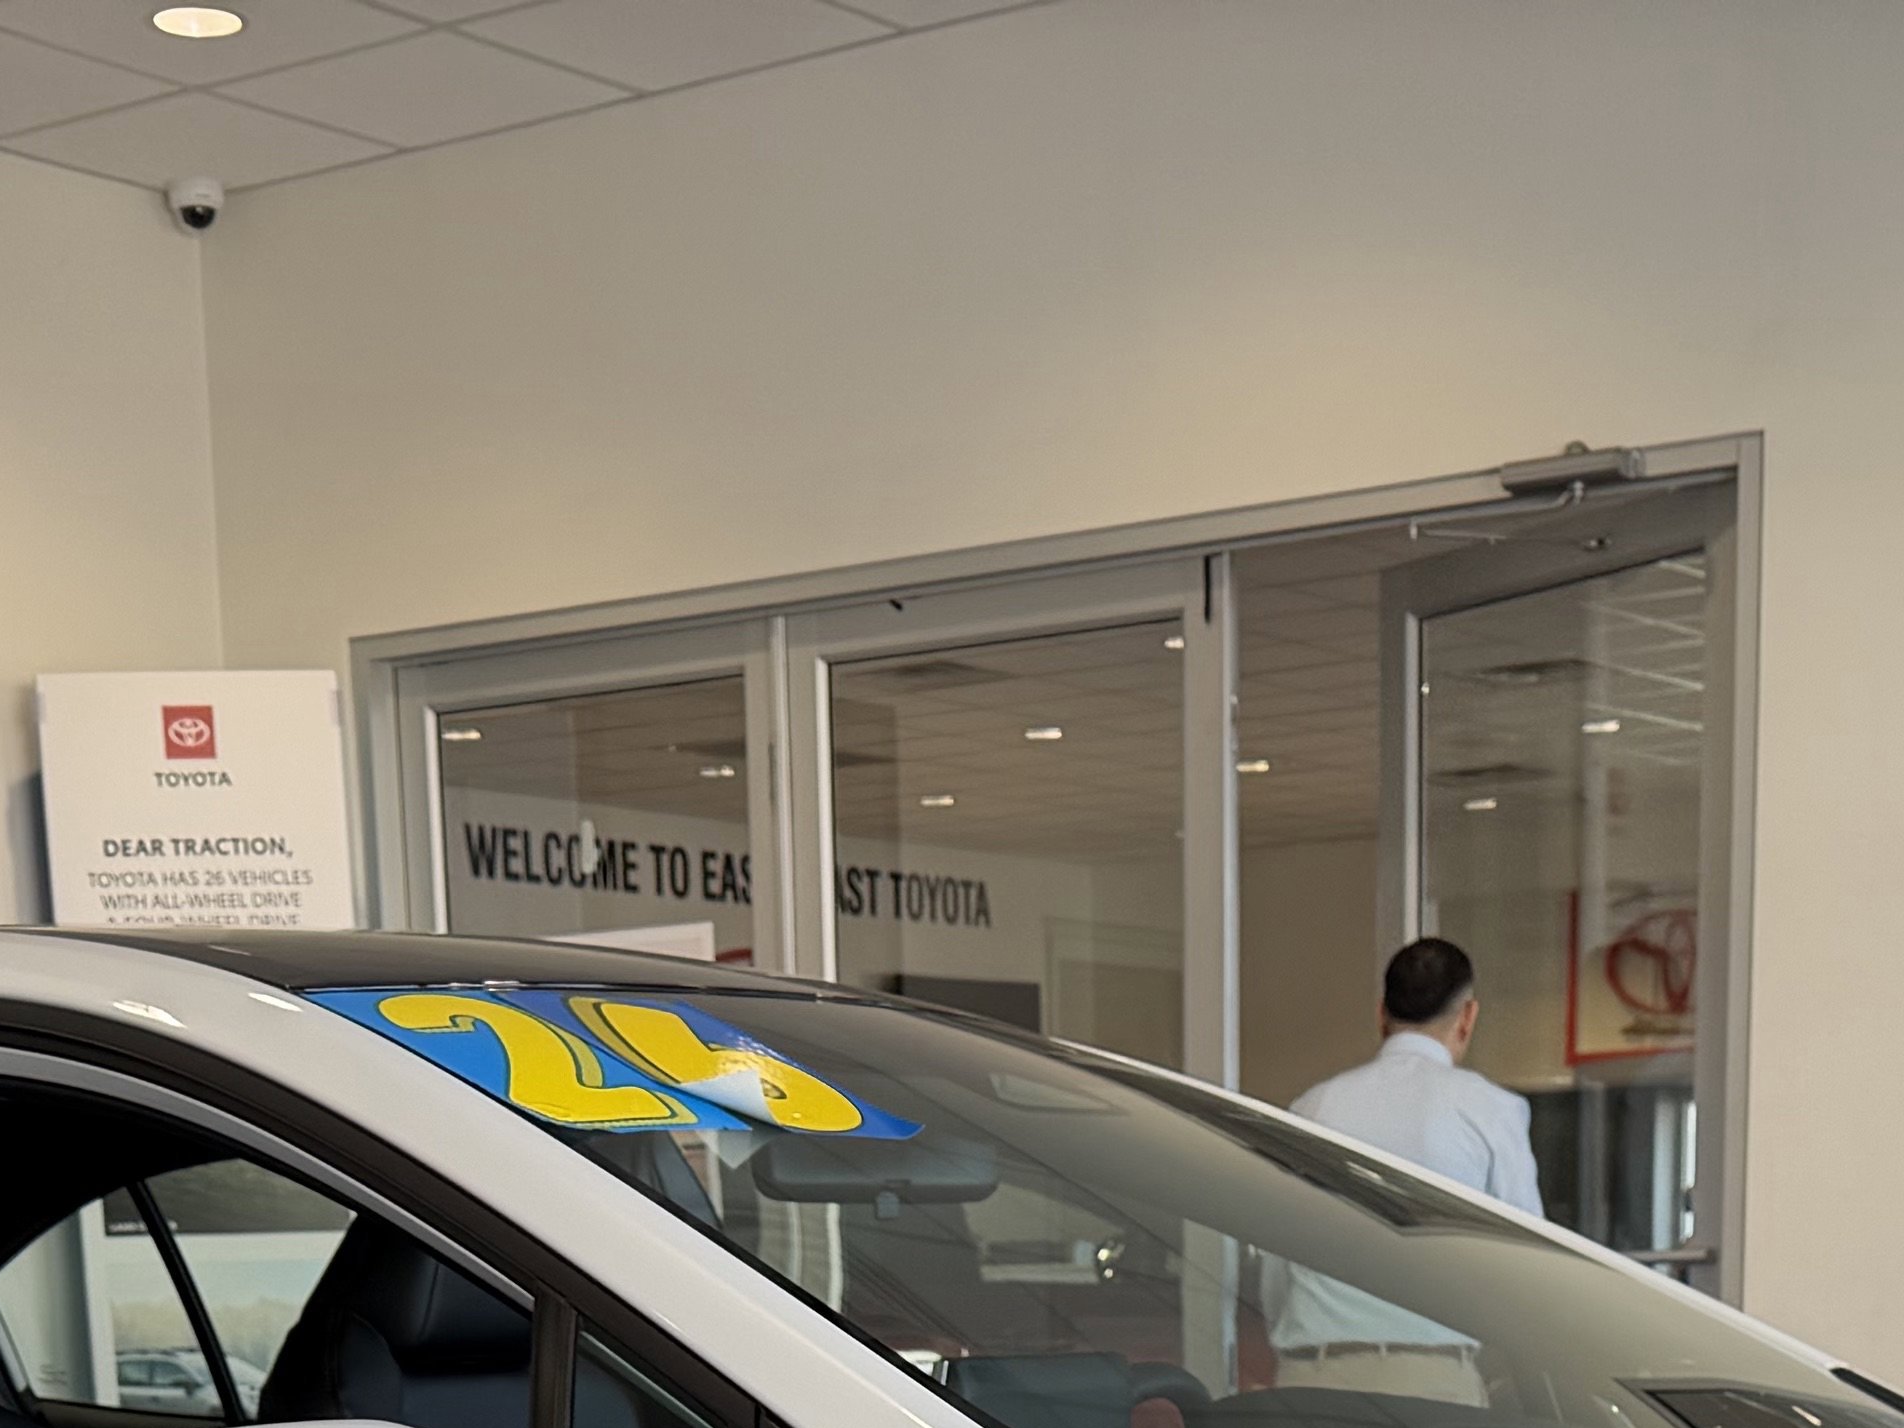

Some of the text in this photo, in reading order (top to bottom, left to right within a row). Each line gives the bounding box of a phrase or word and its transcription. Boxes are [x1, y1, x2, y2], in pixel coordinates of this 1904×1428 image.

[155, 772, 232, 787] TOYOTA
[103, 837, 293, 858] DEAR TRACTION,
[88, 871, 158, 888] TOYOTA
[162, 871, 200, 886] HAS
[227, 869, 313, 886] VEHICLES
[464, 822, 640, 893] WELCOME
[648, 845, 690, 898] TO
[702, 850, 752, 905] EAS
[890, 870, 991, 928] TOYOTA
[100, 892, 302, 910] WITH ALL-WHEEL DRIVE
